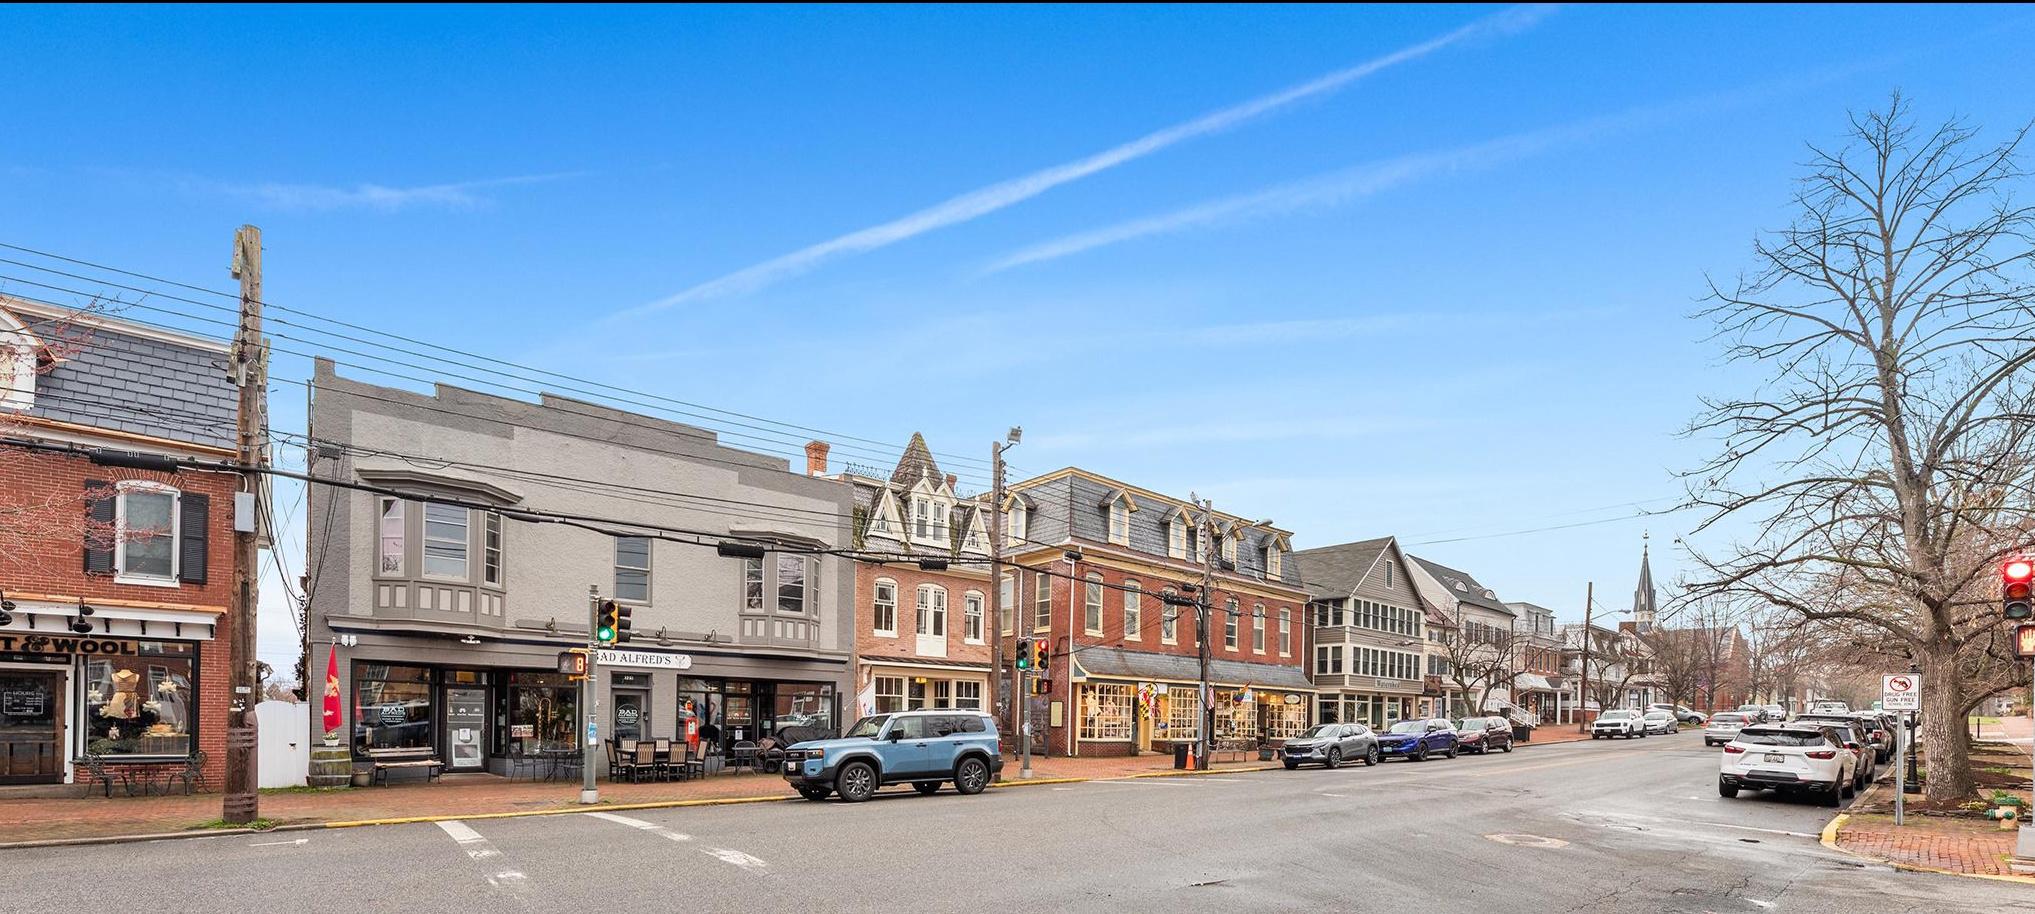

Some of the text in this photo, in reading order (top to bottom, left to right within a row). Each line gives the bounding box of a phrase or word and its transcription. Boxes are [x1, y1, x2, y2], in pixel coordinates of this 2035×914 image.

[52, 638, 136, 655] WOOL
[577, 657, 583, 671] 8
[620, 653, 671, 665] ALFRED'S
